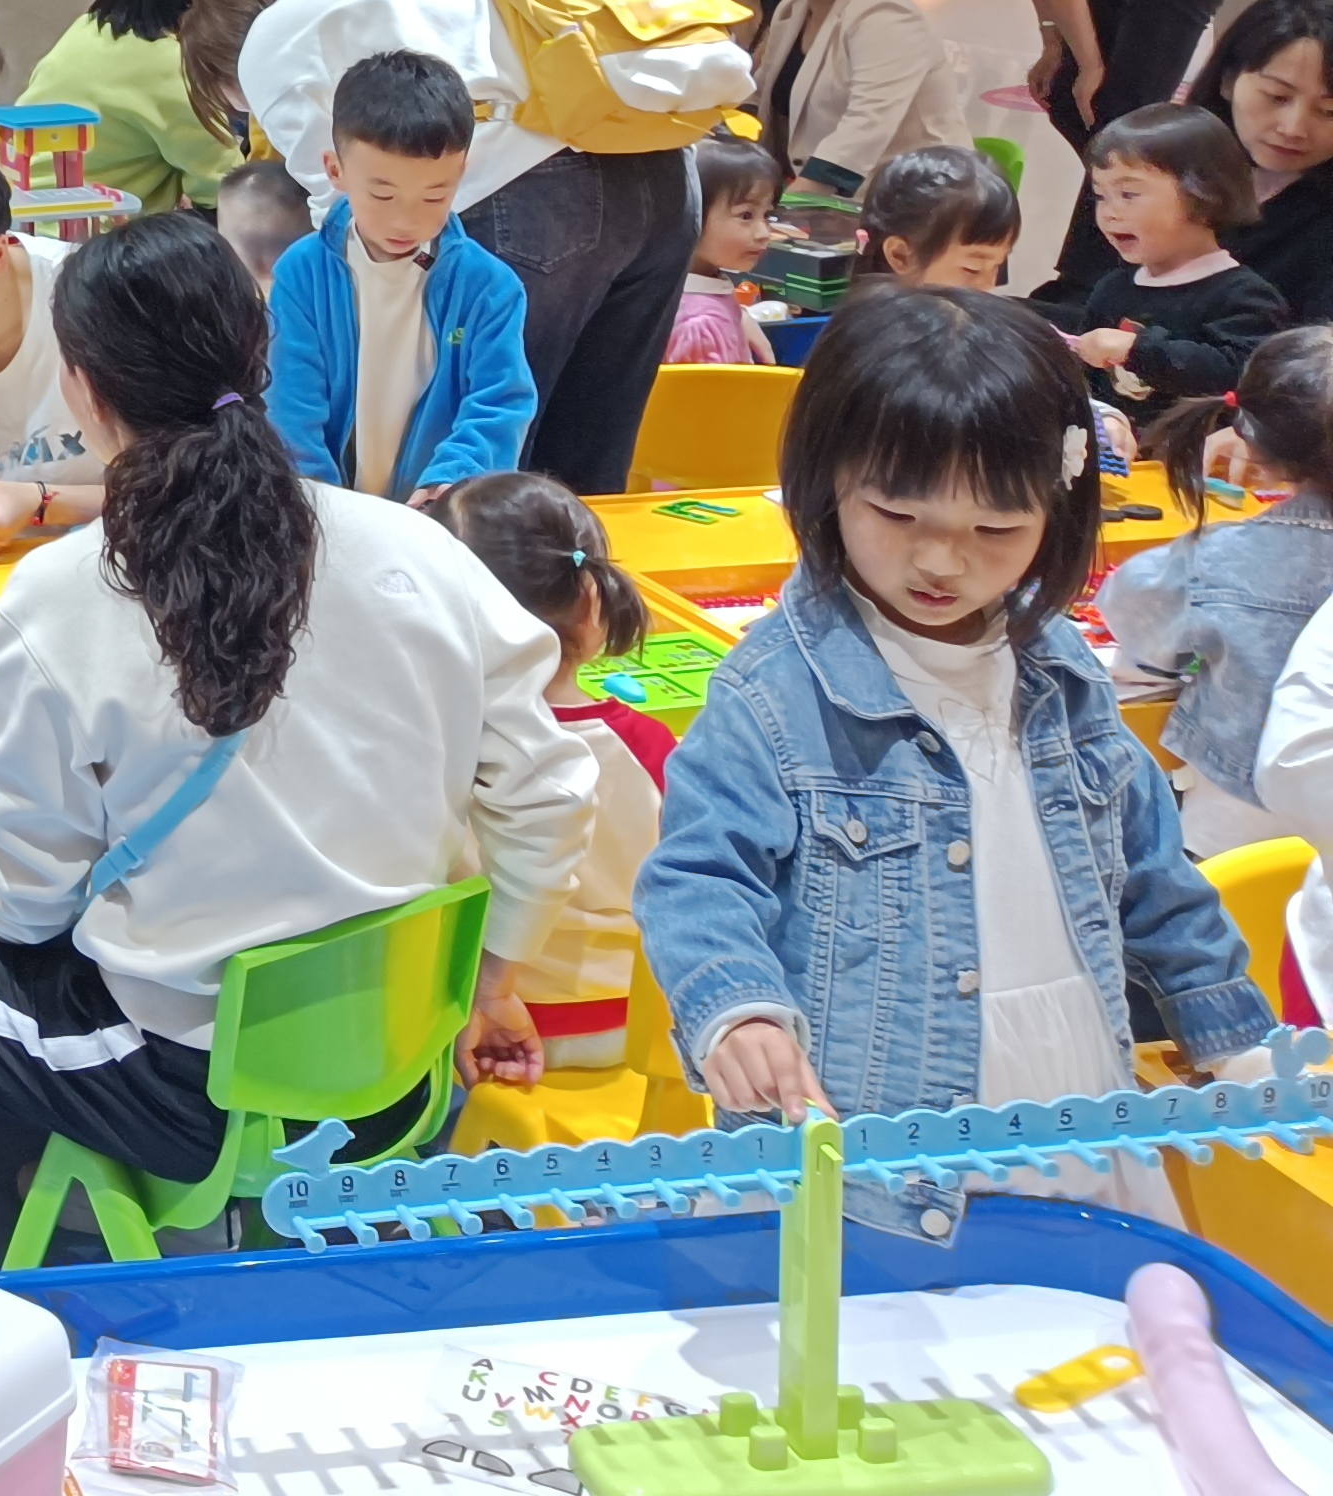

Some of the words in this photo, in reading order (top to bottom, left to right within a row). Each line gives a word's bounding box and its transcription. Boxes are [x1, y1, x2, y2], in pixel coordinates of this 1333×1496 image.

[860, 1127, 868, 1143] 1
[907, 1123, 920, 1139] 2
[958, 1118, 971, 1135] 3
[1008, 1113, 1022, 1130] 4
[1059, 1108, 1072, 1125] 5
[1115, 1100, 1129, 1118] 6
[1167, 1098, 1179, 1115] 7
[1215, 1092, 1227, 1108] 8
[1263, 1087, 1275, 1103] 9
[1310, 1081, 1331, 1099] 10
[286, 1180, 309, 1199] 10
[341, 1175, 354, 1193] 9
[394, 1169, 406, 1187] 8
[446, 1163, 458, 1181] 7
[496, 1158, 509, 1176] 6
[546, 1153, 558, 1170] 5
[597, 1149, 610, 1166] 4
[650, 1145, 662, 1162] 3
[702, 1140, 713, 1157] 2
[756, 1137, 763, 1152] 1
[461, 1384, 486, 1402] U
[494, 1392, 515, 1408] V
[468, 1369, 489, 1386] K
[472, 1358, 494, 1371] A
[538, 1371, 560, 1386] C
[570, 1377, 593, 1394] D
[604, 1385, 621, 1402] E
[637, 1394, 652, 1407] F
